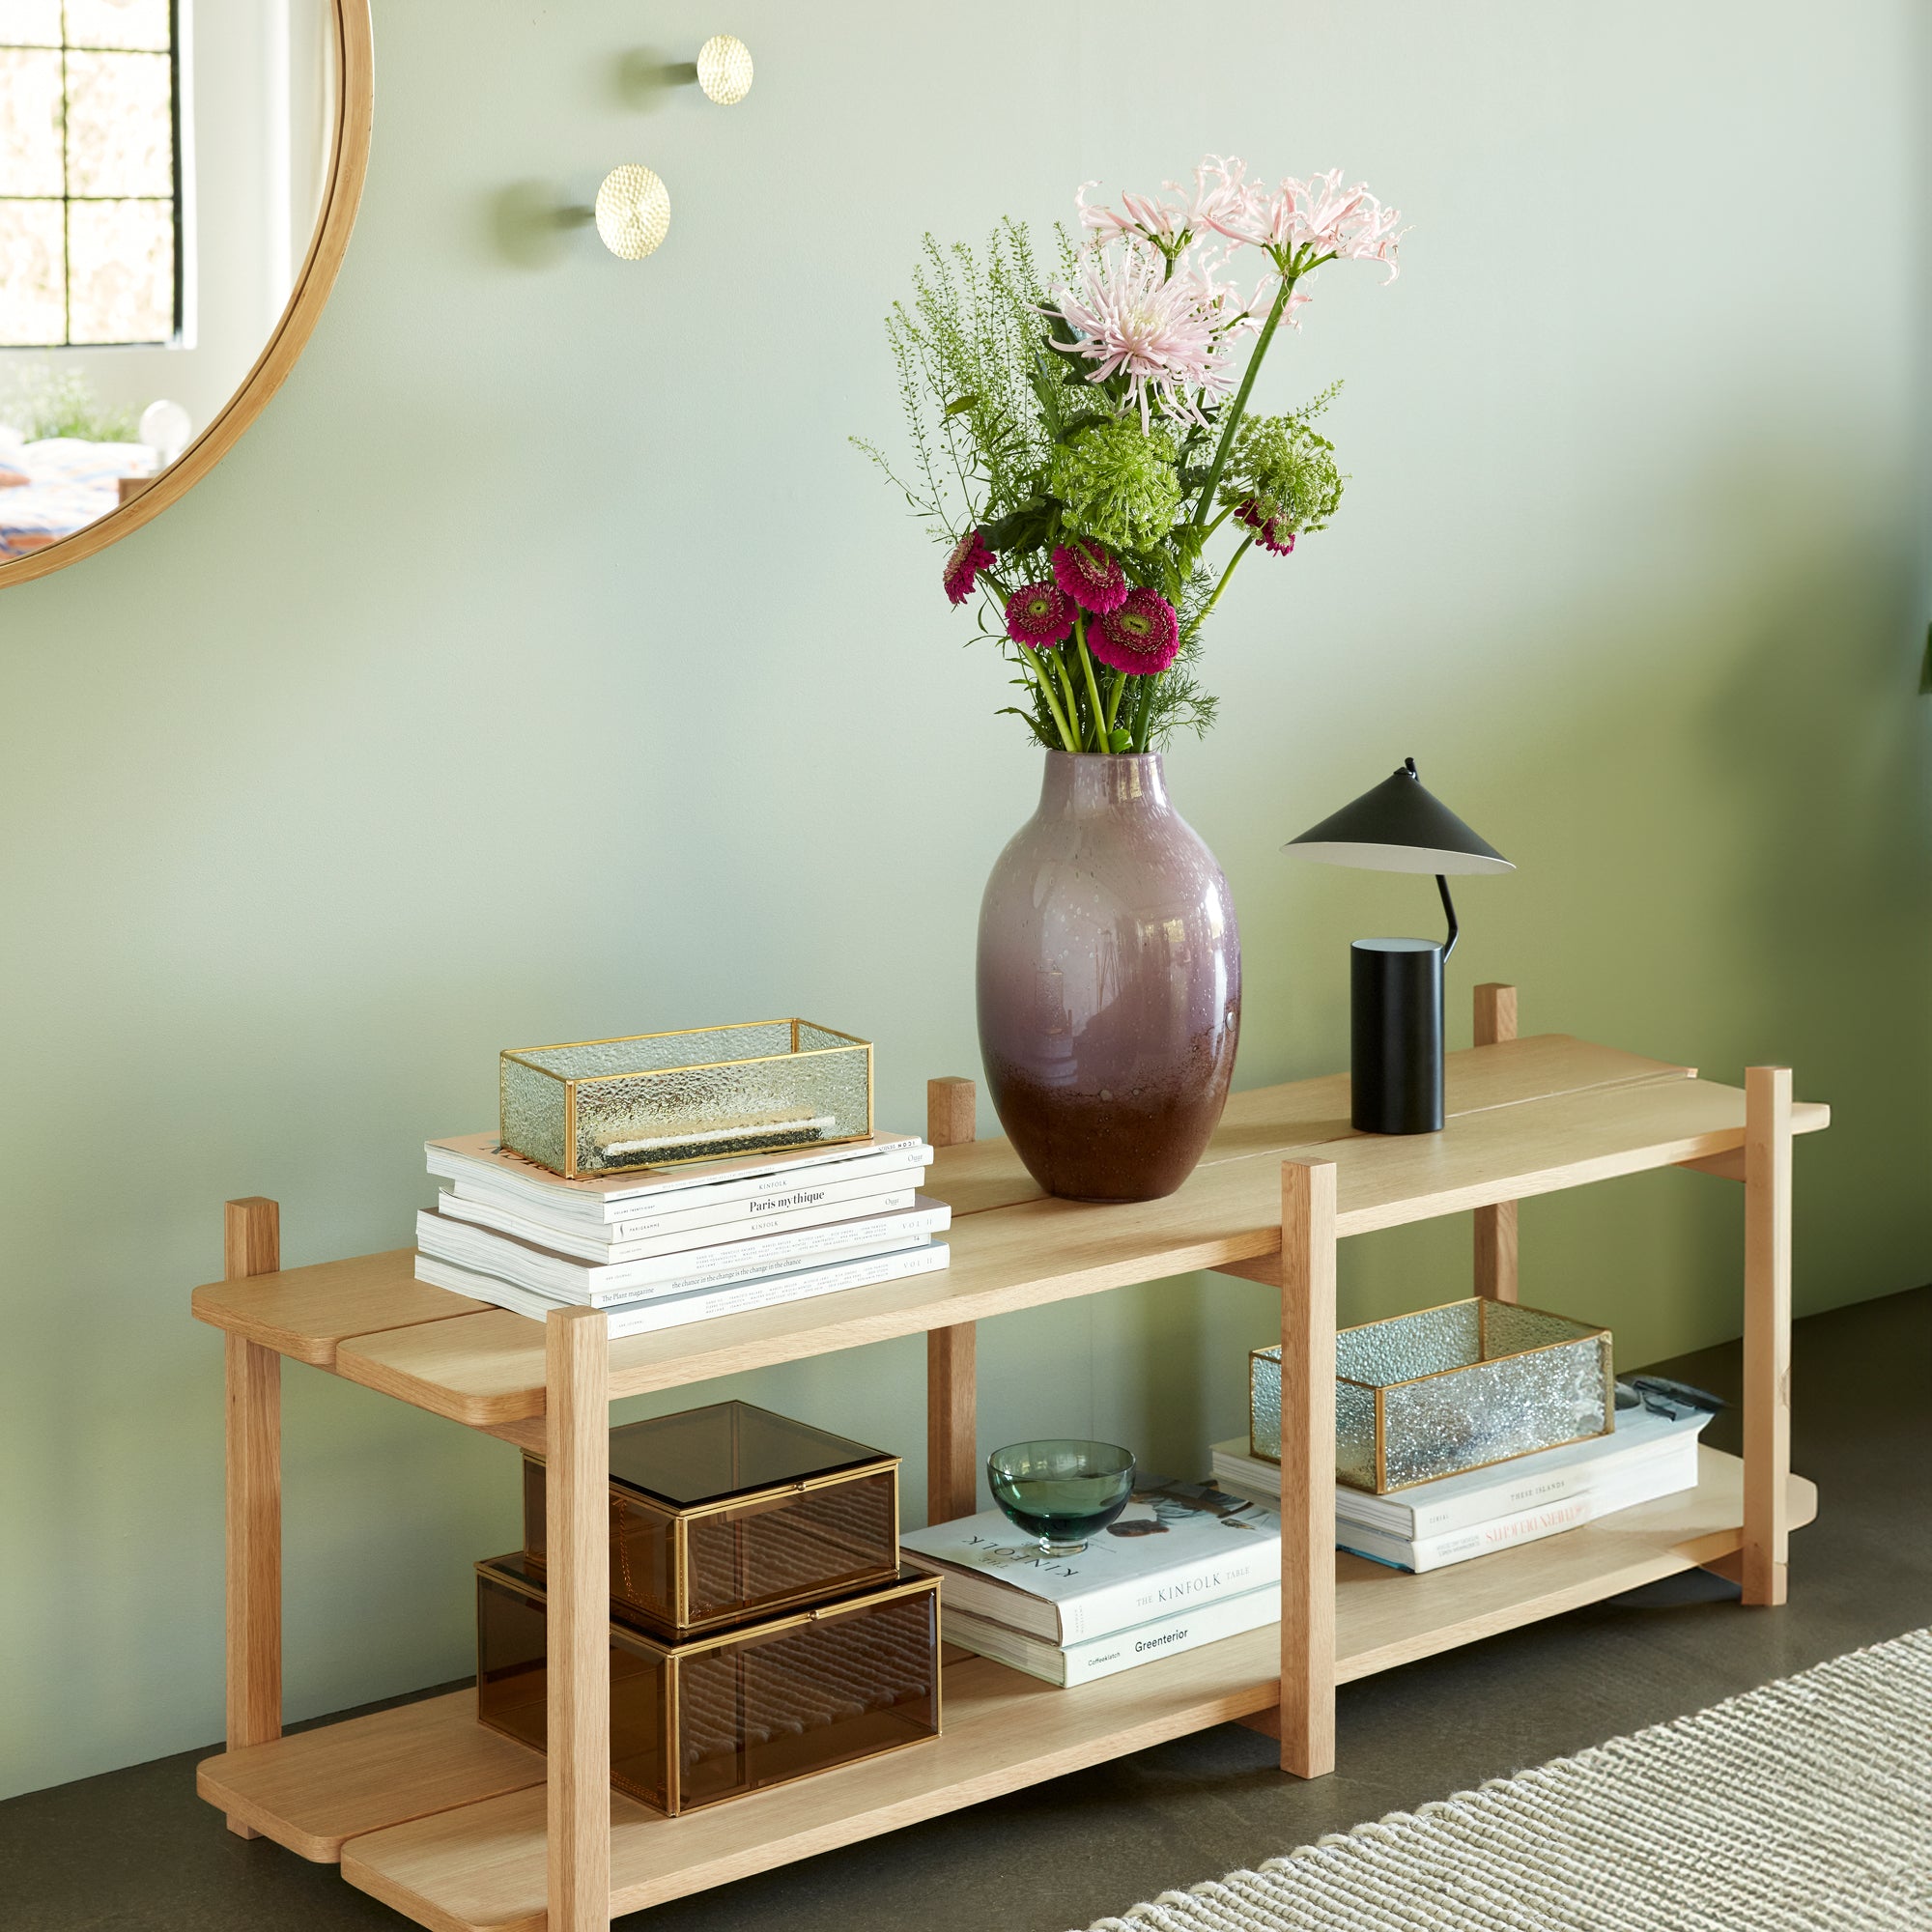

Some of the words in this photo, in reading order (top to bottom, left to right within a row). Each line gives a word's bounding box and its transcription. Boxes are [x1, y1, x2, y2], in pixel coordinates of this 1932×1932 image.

[758, 1179, 787, 1191] KINFOLK
[749, 1198, 776, 1213] Paris
[778, 1190, 825, 1209] mythique
[751, 1220, 779, 1231] KINFOLK
[602, 1293, 612, 1303] The
[612, 1291, 628, 1301] Plant
[629, 1286, 655, 1299] magazine
[671, 1280, 681, 1290] the
[681, 1276, 700, 1288] chance
[706, 1273, 716, 1283] the
[716, 1271, 735, 1282] change
[740, 1266, 749, 1276] the
[749, 1264, 768, 1275] change
[774, 1261, 783, 1270] the
[783, 1258, 802, 1268] chance
[1510, 1489, 1533, 1502] THESE
[1535, 1480, 1565, 1496] ISLANDS
[961, 1535, 1079, 1577] KINFOLK
[1136, 1595, 1154, 1607] THE
[1157, 1572, 1222, 1604] KINFOLK
[1226, 1566, 1251, 1581] TABLE
[1134, 1629, 1189, 1654] Greenterior
